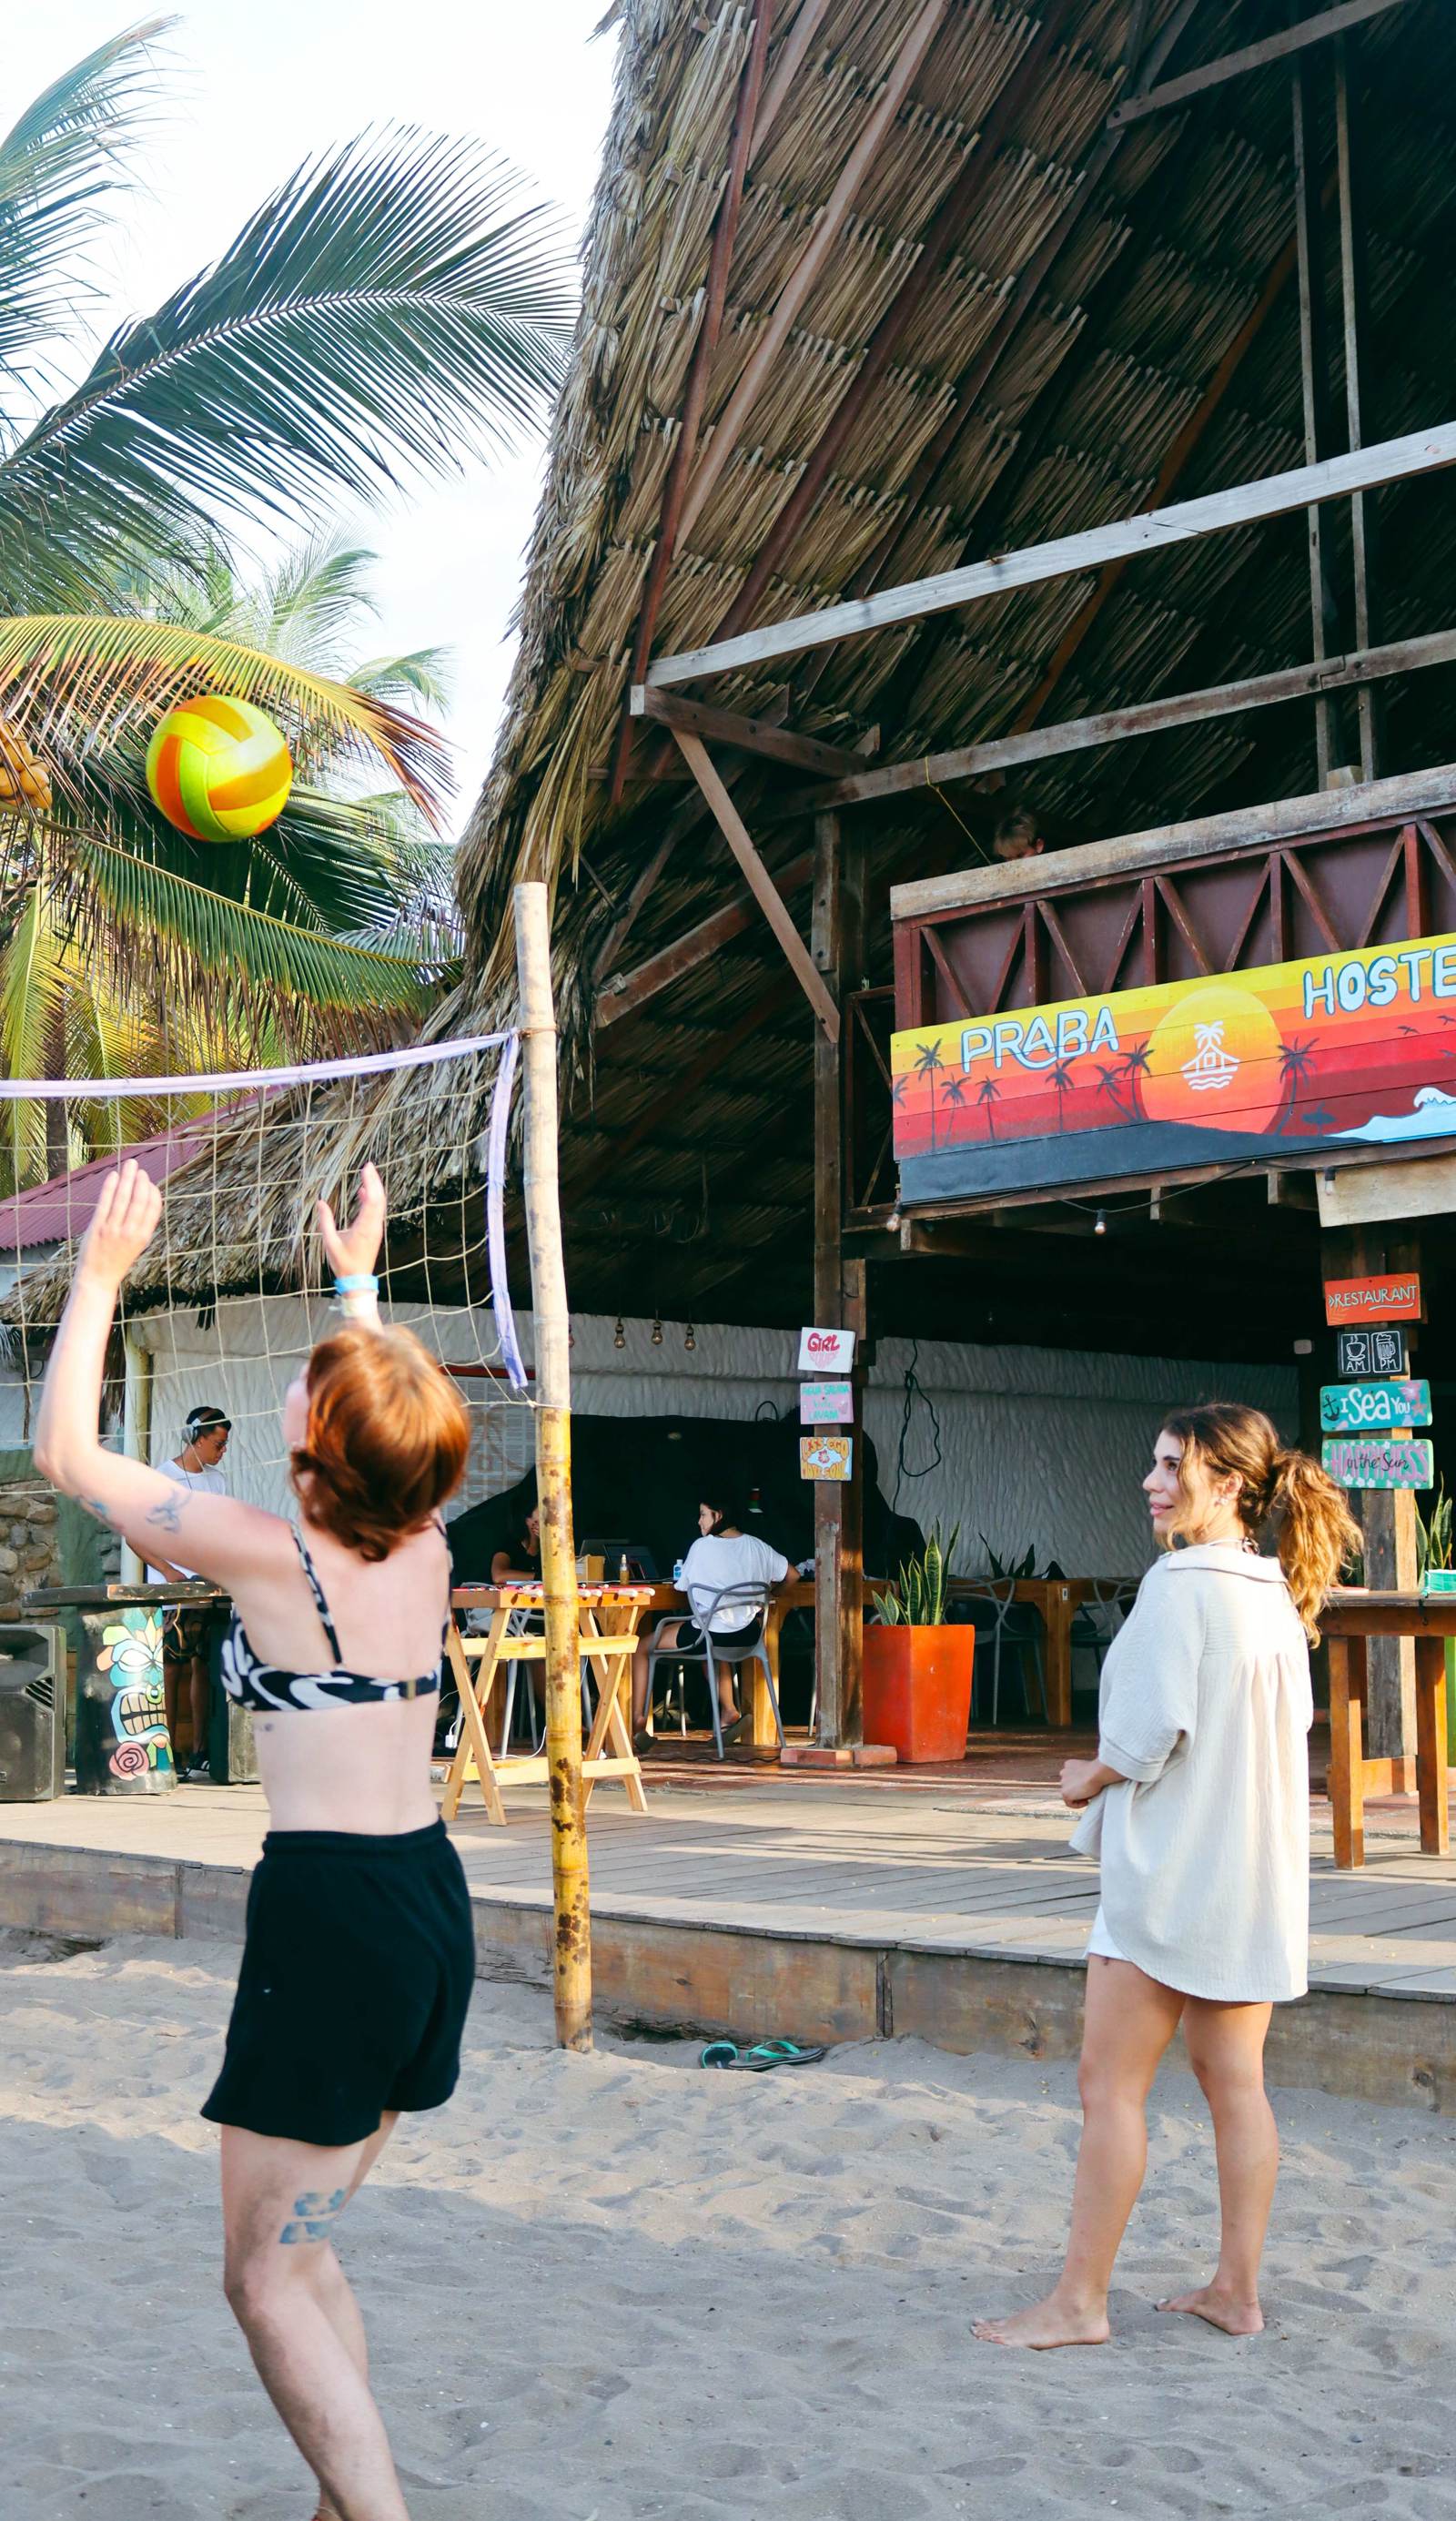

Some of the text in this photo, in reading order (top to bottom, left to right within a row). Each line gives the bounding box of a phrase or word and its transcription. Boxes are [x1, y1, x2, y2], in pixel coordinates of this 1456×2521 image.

[961, 945, 1456, 1074] PRABA HOSTE
[1334, 1285, 1417, 1311] RESTAURANT
[807, 1332, 841, 1352] GIRL
[1346, 1361, 1366, 1372] AM
[1340, 1397, 1349, 1413] I
[1359, 1453, 1378, 1470] the
